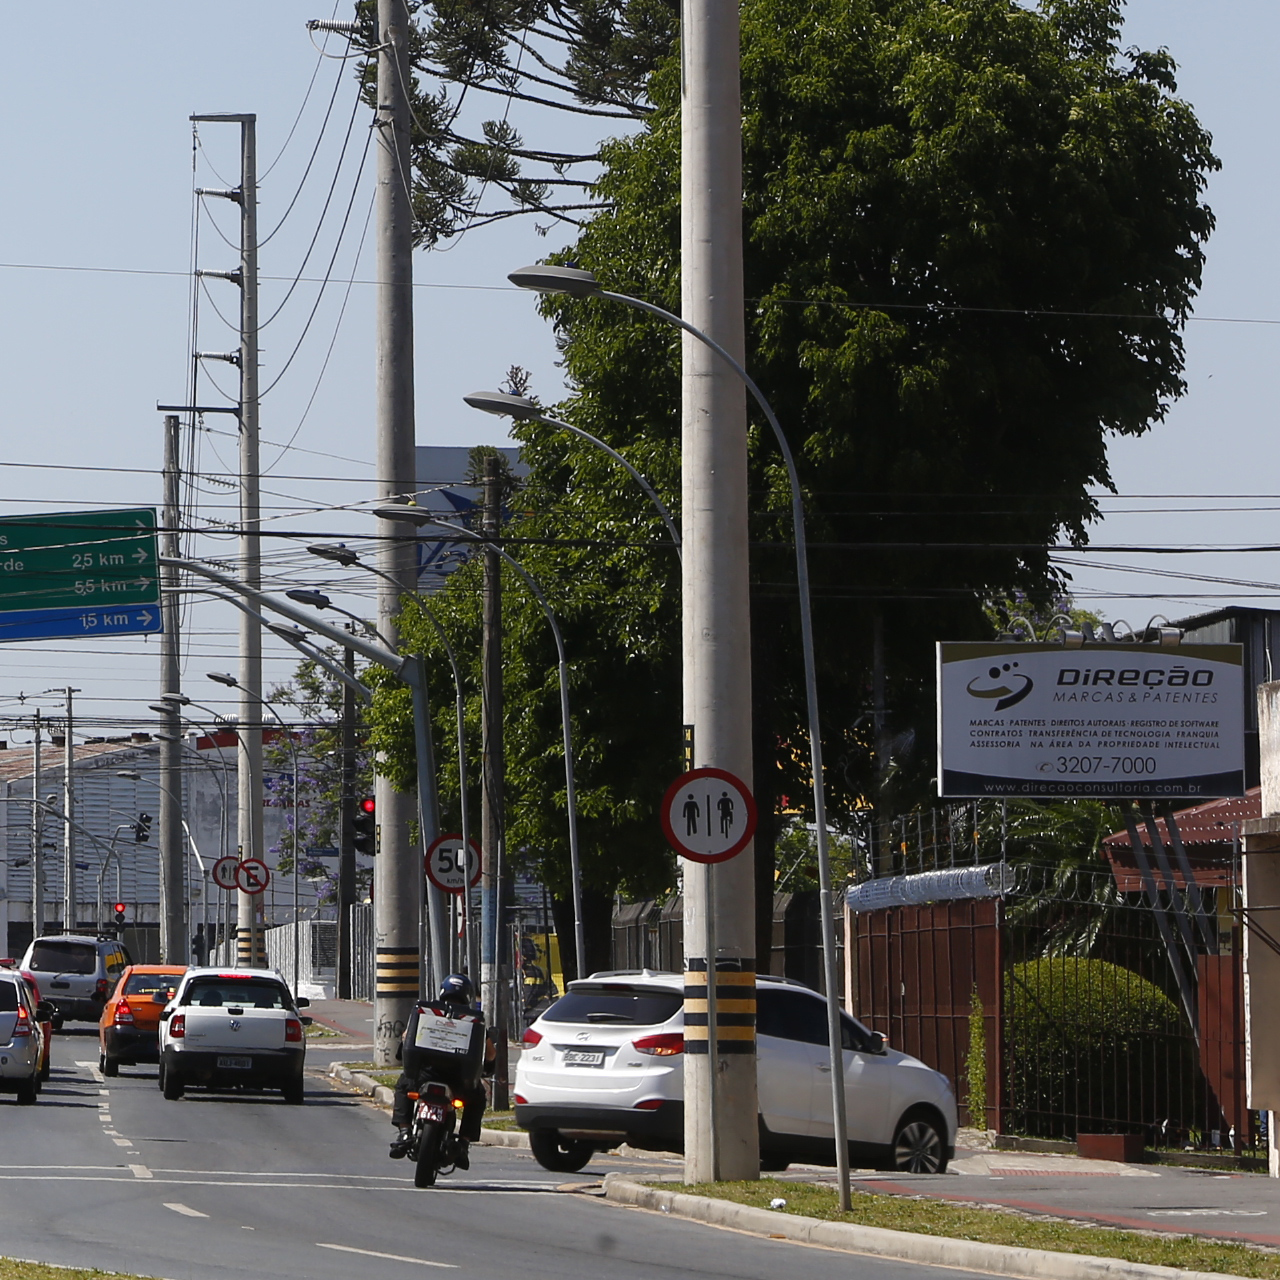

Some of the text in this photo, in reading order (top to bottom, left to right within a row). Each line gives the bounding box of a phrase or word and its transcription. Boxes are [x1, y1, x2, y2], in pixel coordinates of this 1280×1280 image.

[72, 553, 93, 570] 2,5
[99, 552, 125, 567] km
[74, 579, 95, 596] 5,5
[101, 578, 127, 593] km
[79, 612, 98, 631] 1,5
[103, 612, 129, 627] km
[1052, 691, 1218, 704] MARCAS & PATENTES
[969, 720, 1219, 729] MARCAS PATENTES DIREITOS AUTORAIS REGISTRO DE SOFTWARE
[969, 728, 1219, 739] CONTRATOS TRANSFERÊNCIA DE TECNOLOGIA FRANQUIA
[969, 738, 1220, 749] ASSESSORIA NA ÁREA DA PROPRIEDADE INTELECTUAL
[1056, 756, 1156, 774] 3207-7000
[984, 781, 1201, 794] www.direcaoconsultoria.com.br
